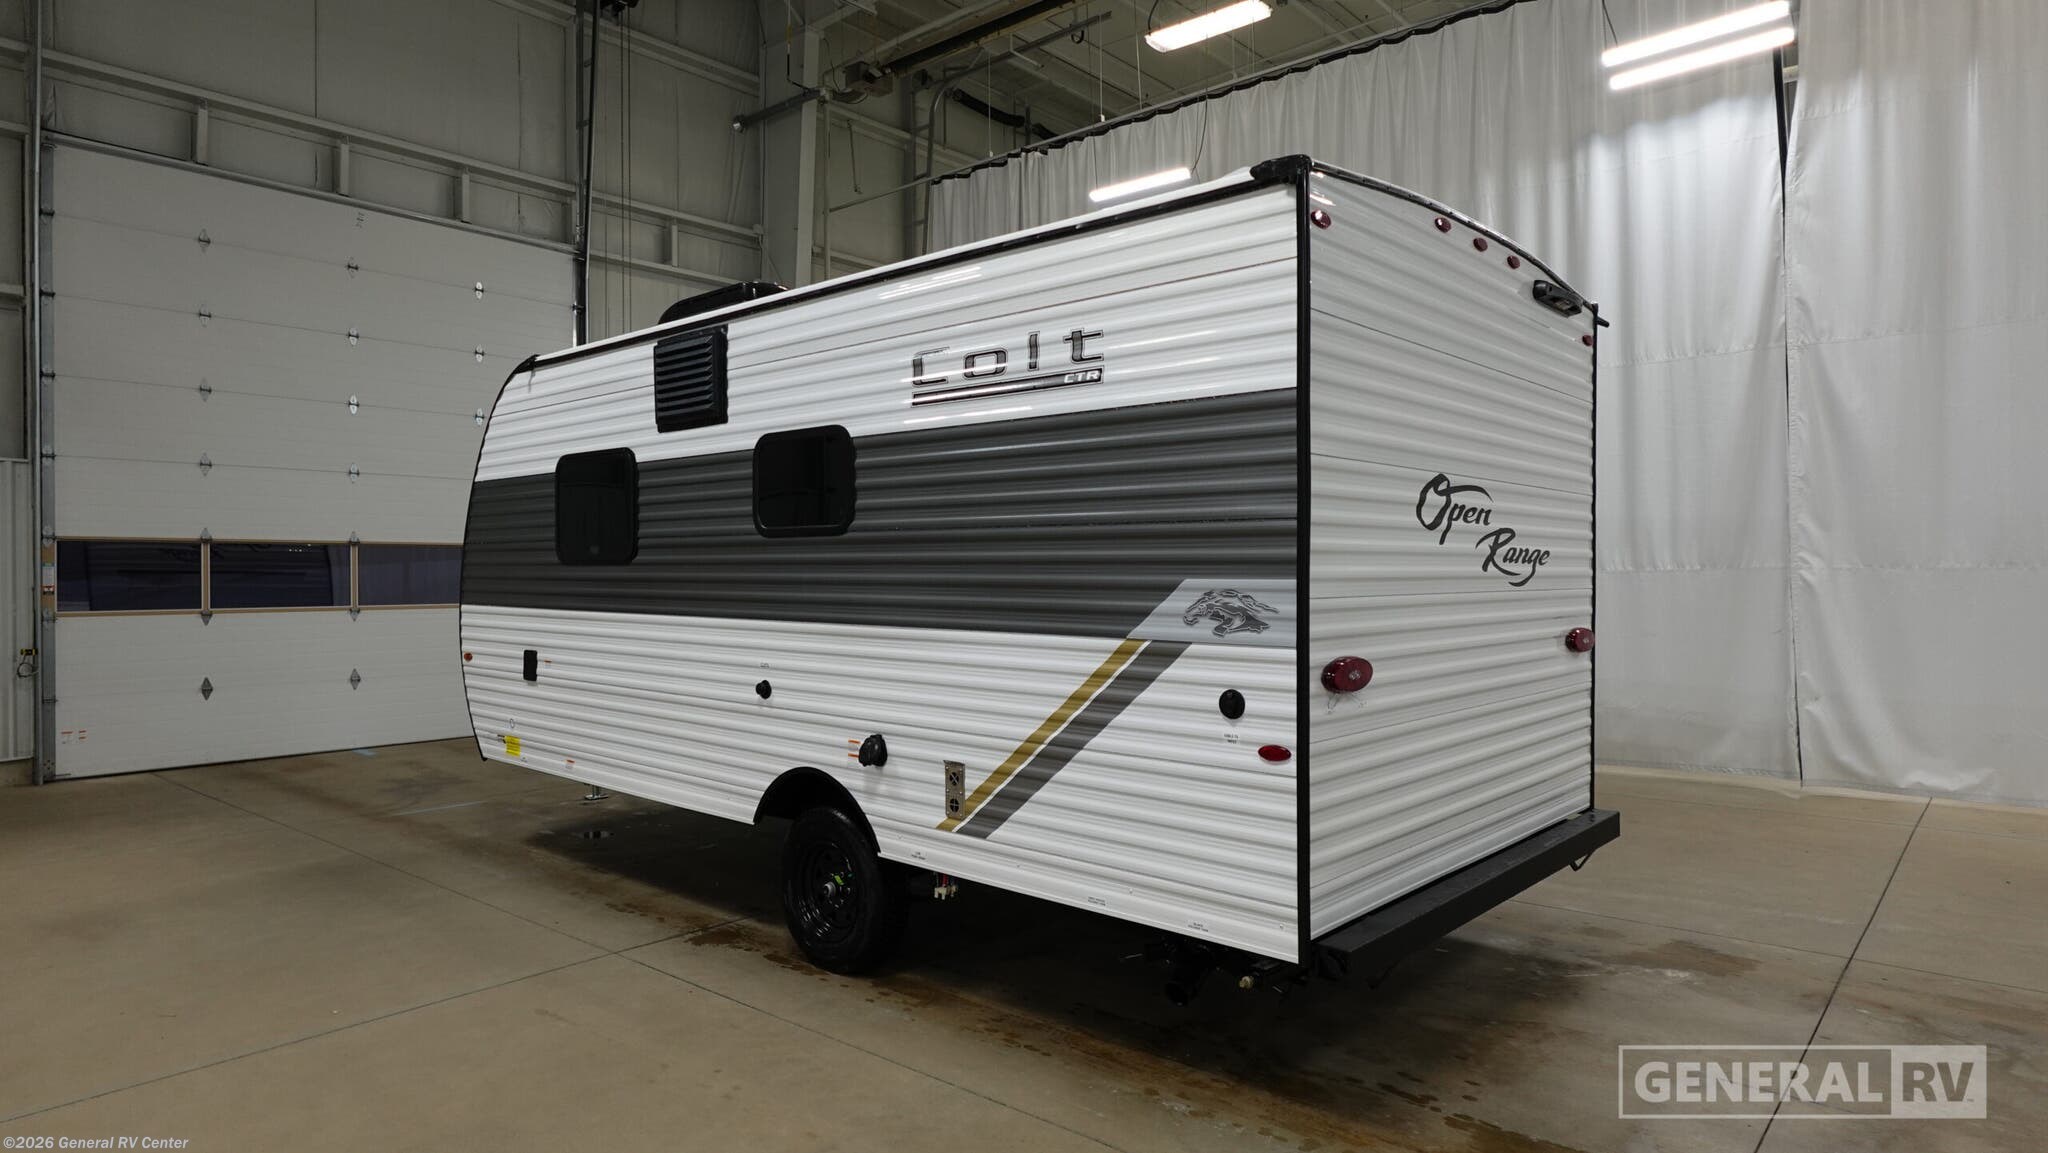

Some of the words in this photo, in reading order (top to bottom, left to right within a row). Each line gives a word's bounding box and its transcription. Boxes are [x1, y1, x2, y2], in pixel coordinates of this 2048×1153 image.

[912, 327, 1104, 387] Colt
[1063, 370, 1100, 384] CTR
[1415, 473, 1493, 545] Open
[1475, 527, 1550, 587] Range
